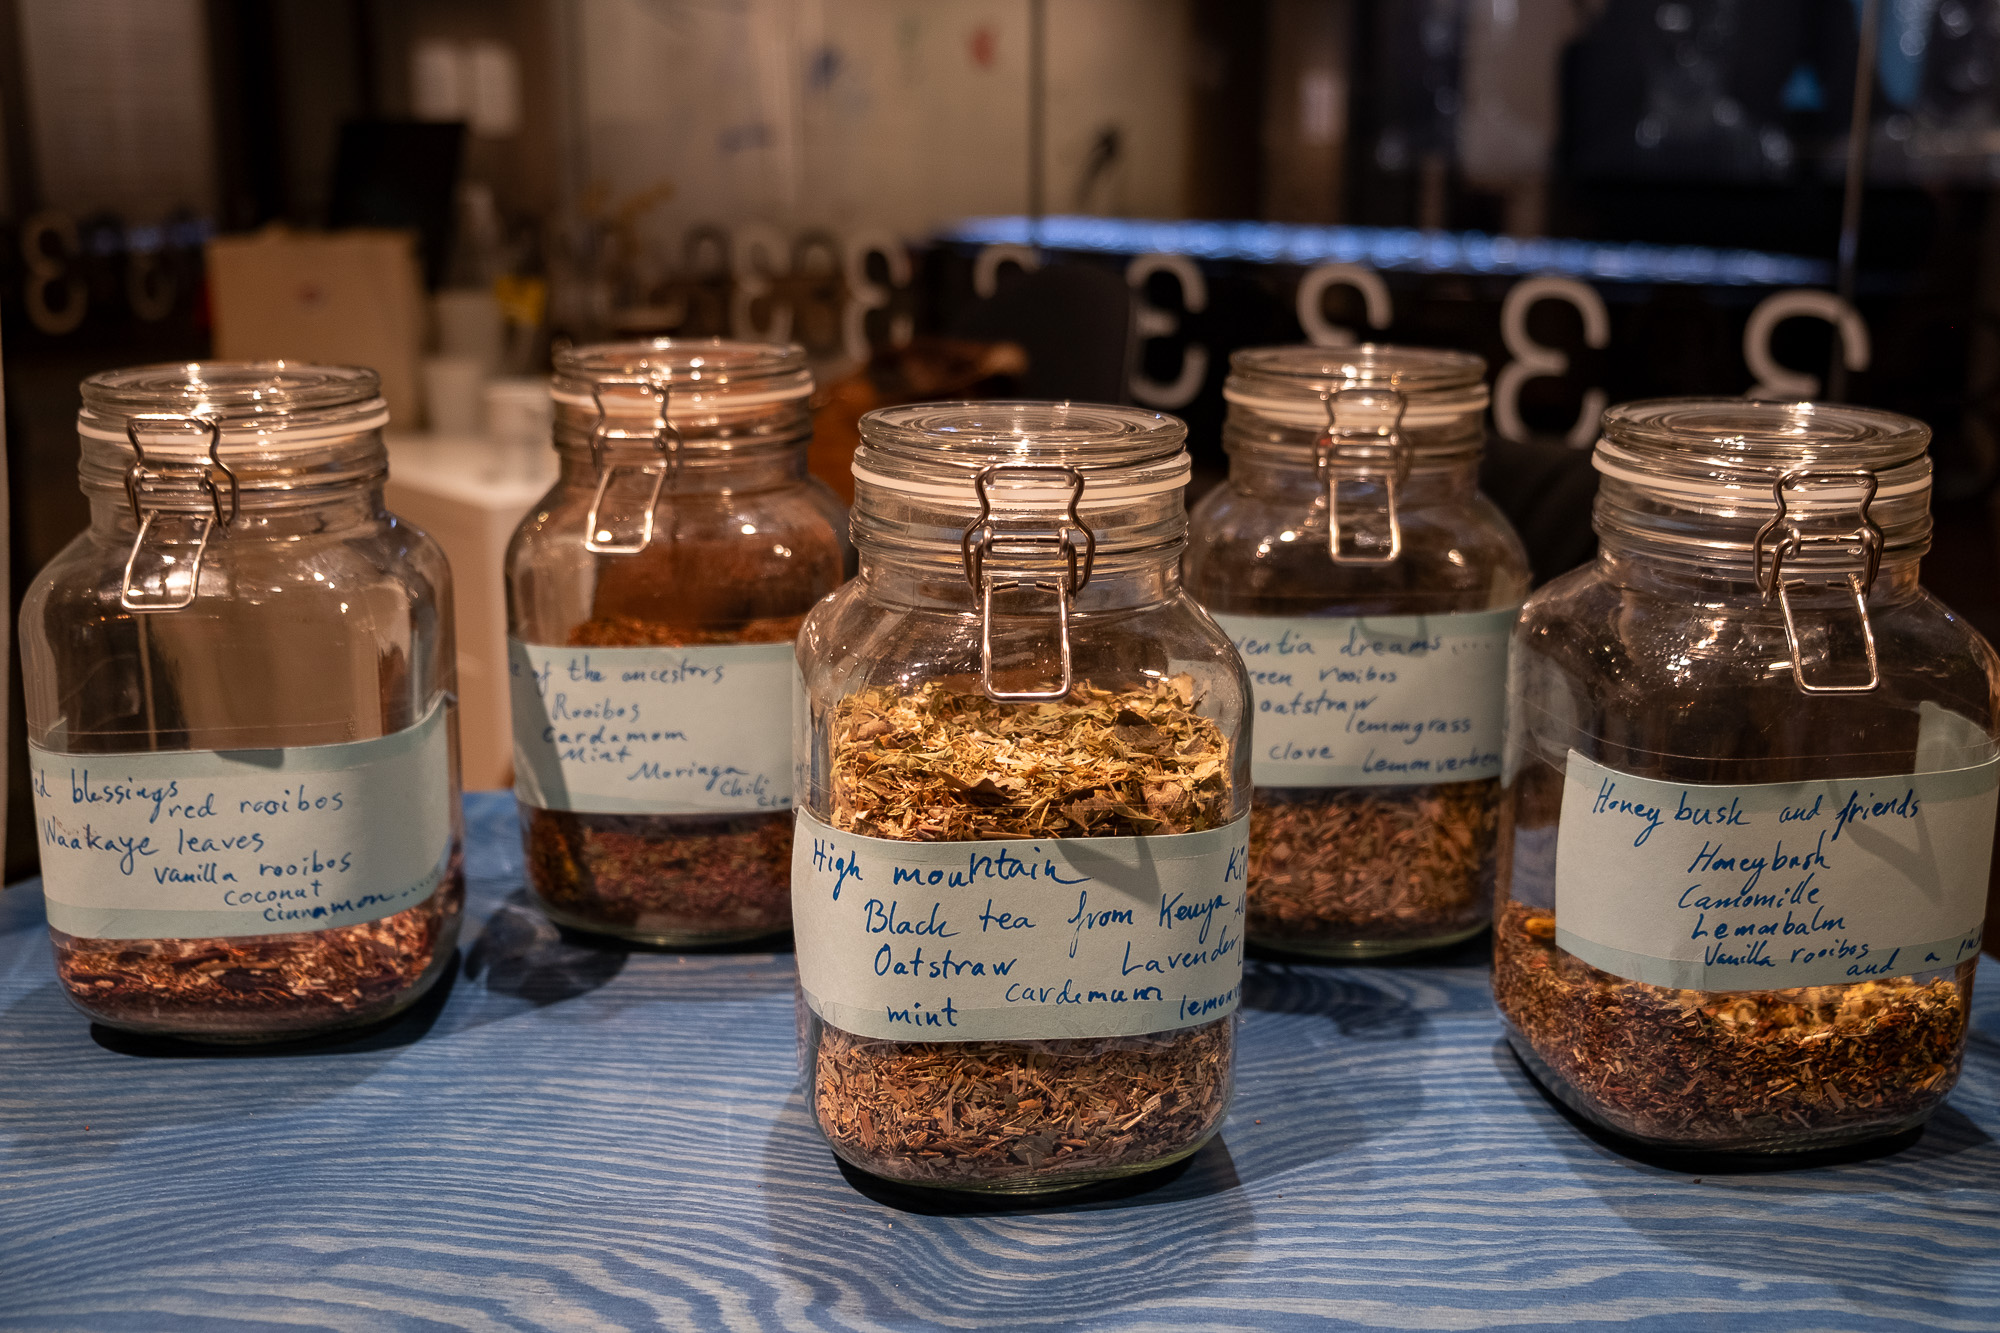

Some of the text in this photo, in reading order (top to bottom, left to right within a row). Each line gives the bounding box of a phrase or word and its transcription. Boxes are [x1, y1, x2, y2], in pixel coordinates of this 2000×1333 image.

[1341, 626, 1442, 655] dreams
[621, 656, 724, 684] ancestors
[552, 692, 640, 722] Rooibos
[71, 767, 179, 823] blessings
[168, 793, 218, 819] red
[240, 785, 344, 815] rooibos
[1778, 794, 1824, 824] and
[1829, 789, 1920, 842] friends
[178, 827, 265, 854] leaves
[259, 850, 352, 878] rooibos
[812, 838, 863, 900] High
[893, 846, 1094, 887] mountain
[223, 879, 323, 907] coconut
[1678, 872, 1820, 910] Camomille
[864, 898, 960, 937] Black
[979, 898, 1036, 932] tea
[1067, 890, 1134, 958] from
[1159, 892, 1230, 945] Kenya
[873, 943, 1018, 978] Oatstraw
[1121, 924, 1240, 977] Lavender
[1704, 939, 1870, 968] Vanilla rooibos
[1846, 946, 1901, 976] and
[1924, 951, 1941, 963] a
[887, 997, 959, 1028] mint
